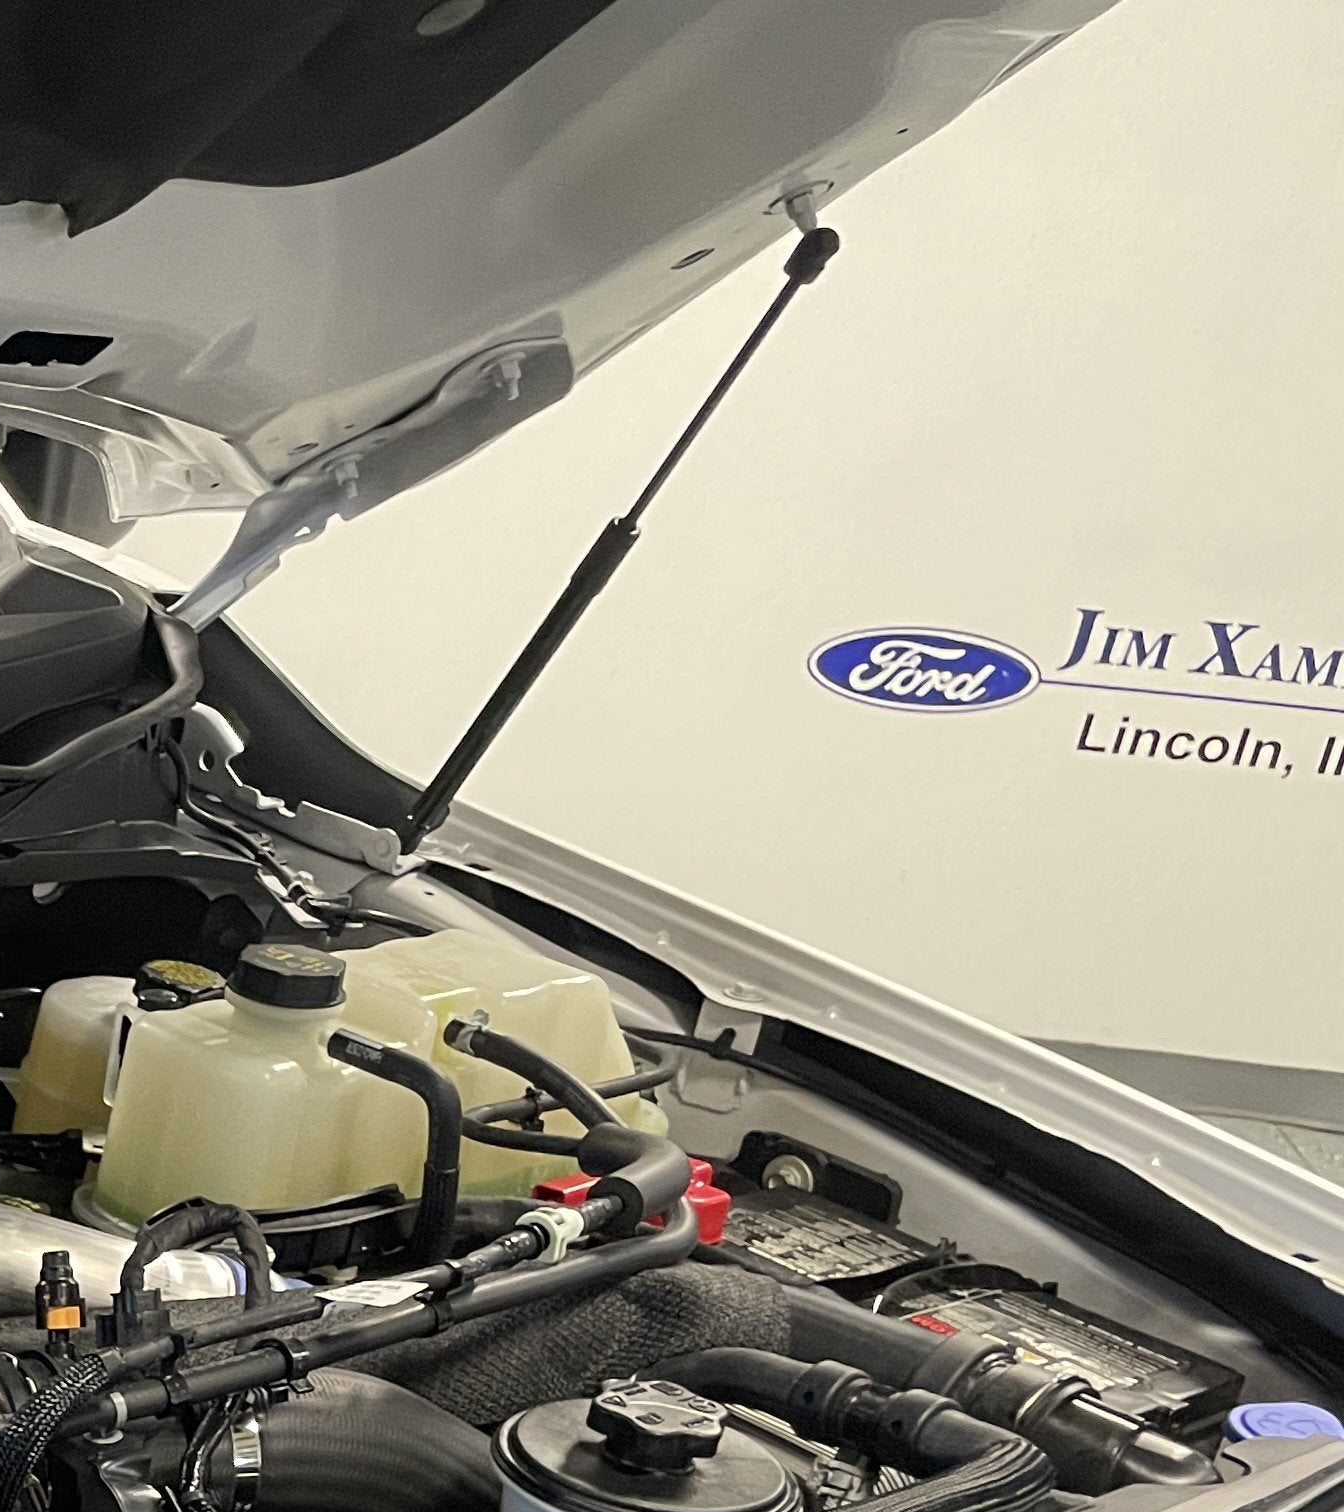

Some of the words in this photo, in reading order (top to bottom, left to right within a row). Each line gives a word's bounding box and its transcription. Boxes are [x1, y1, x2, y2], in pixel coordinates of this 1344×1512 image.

[848, 640, 996, 703] Ford
[1059, 608, 1177, 671] JIM
[1188, 620, 1343, 691] XAM
[1075, 712, 1295, 779] Lincoln,
[1317, 736, 1343, 778] I
